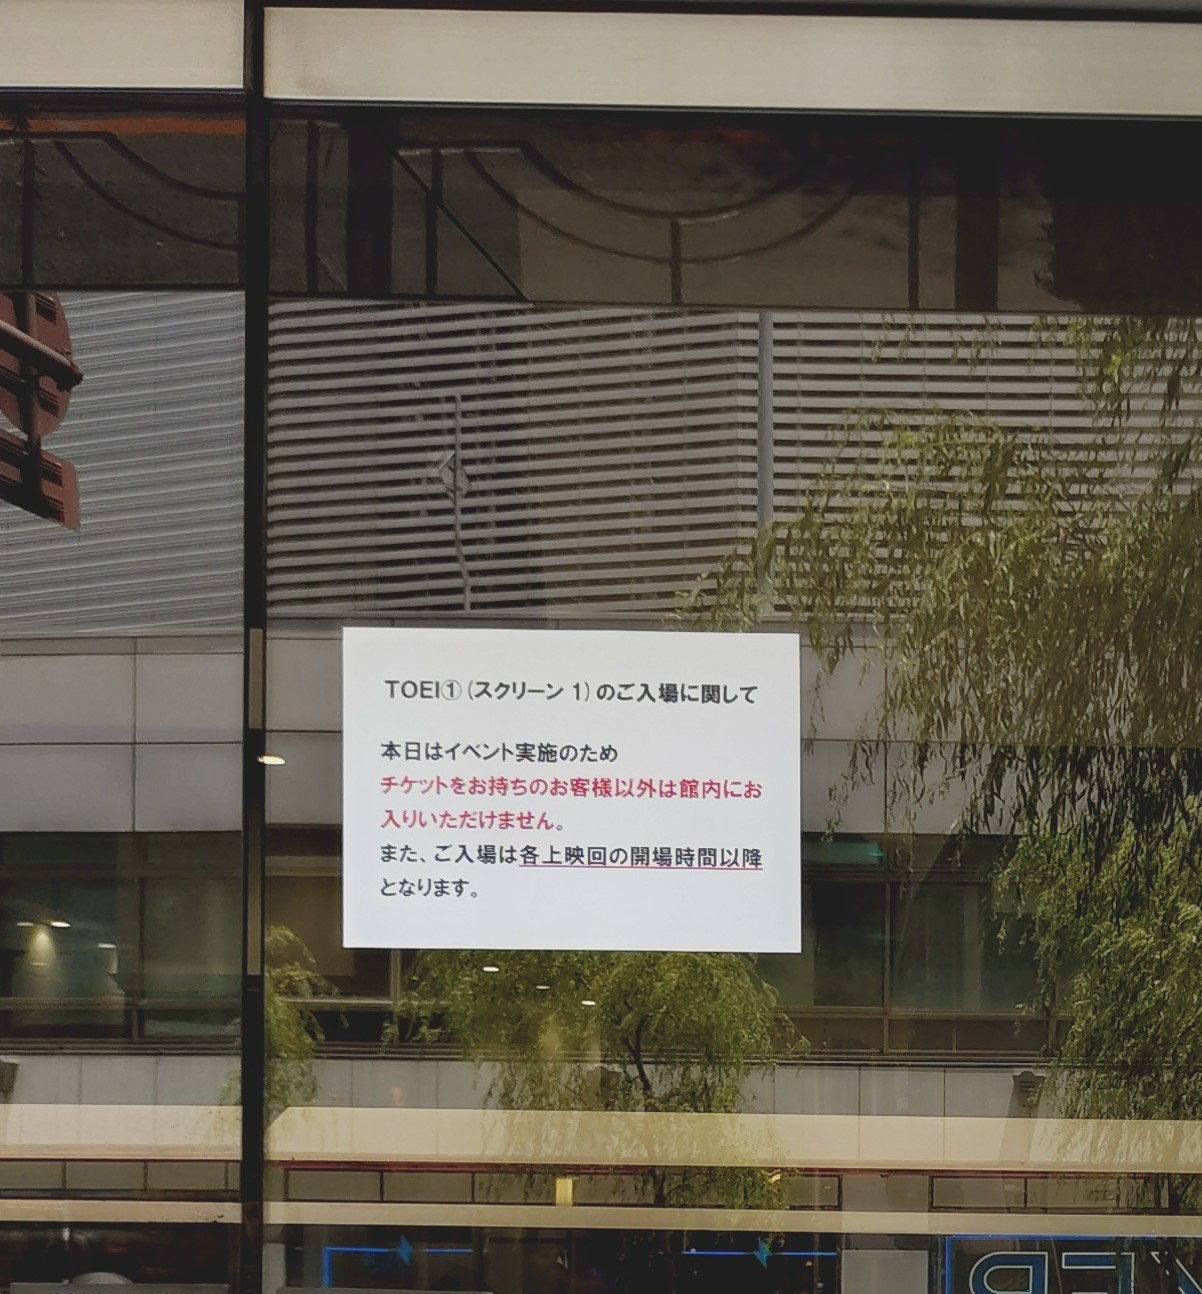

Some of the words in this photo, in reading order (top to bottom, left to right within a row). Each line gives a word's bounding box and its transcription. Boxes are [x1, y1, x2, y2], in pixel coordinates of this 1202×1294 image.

[380, 741, 619, 764] 本日はイベント実施のため
[380, 776, 763, 800] チケットをお持ちのお客様以外は館内にお
[380, 810, 564, 832] 入りいただけません。
[380, 844, 763, 869] また、ご入場は各上映回の開場時間以降
[380, 878, 478, 899] となります。
